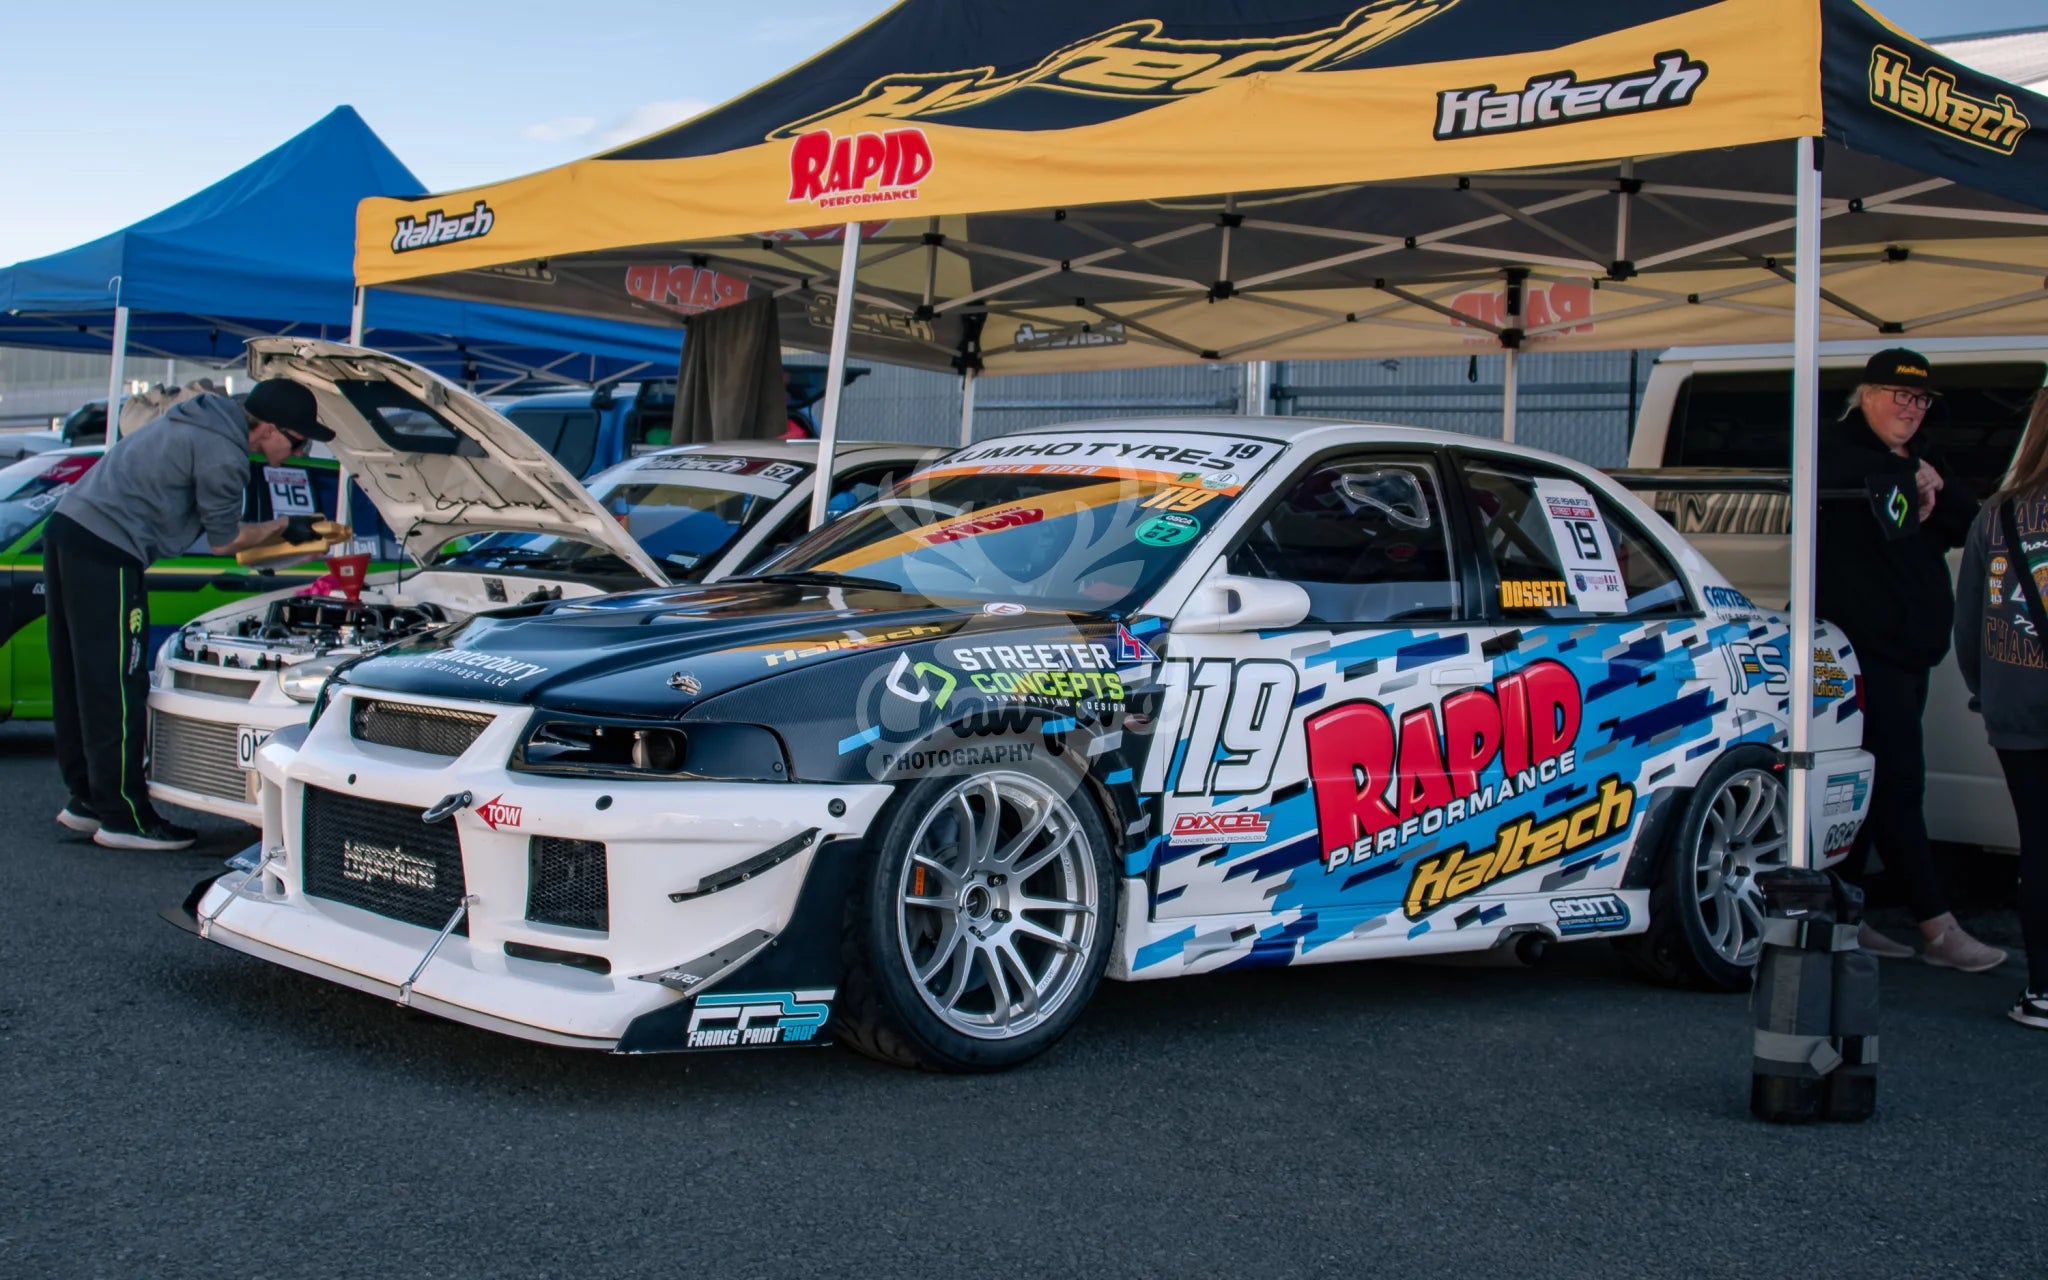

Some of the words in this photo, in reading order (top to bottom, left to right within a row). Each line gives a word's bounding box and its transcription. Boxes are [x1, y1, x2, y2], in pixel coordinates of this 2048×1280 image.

[1436, 52, 1705, 138] Haltech
[1871, 48, 2027, 151] Haltech
[789, 128, 933, 200] RAPID
[819, 189, 918, 208] PERFORMANCE
[392, 202, 493, 252] Haltech
[1084, 442, 1236, 470] TYRES
[1224, 443, 1263, 459] 19
[764, 463, 794, 478] 52
[273, 483, 309, 506] 46
[1140, 486, 1220, 512] 119
[1165, 515, 1194, 525] OSCA
[1564, 520, 1602, 560] 19
[1501, 581, 1567, 607] DOSSETT
[763, 625, 941, 667] Haltech
[953, 643, 1115, 671] STREETER
[424, 660, 484, 680] Drainage
[484, 674, 513, 687] Ltd
[970, 671, 1126, 700] CONCEPTS
[986, 695, 1071, 708] SIGNWRITING
[1087, 701, 1126, 711] DESIGN
[1139, 657, 1299, 797] 119
[1304, 658, 1582, 864] RAPID
[488, 804, 521, 824] TOW
[1174, 813, 1267, 831] DIXCEL
[1327, 749, 1576, 874] PERFORMANCE
[1171, 837, 1205, 845] ADVANCED
[1405, 776, 1635, 919] Haltech
[1551, 896, 1619, 918] SCOTT
[687, 1030, 739, 1047] FRANKS
[742, 1027, 781, 1045] PAINT
[782, 1025, 818, 1042] SHOP
